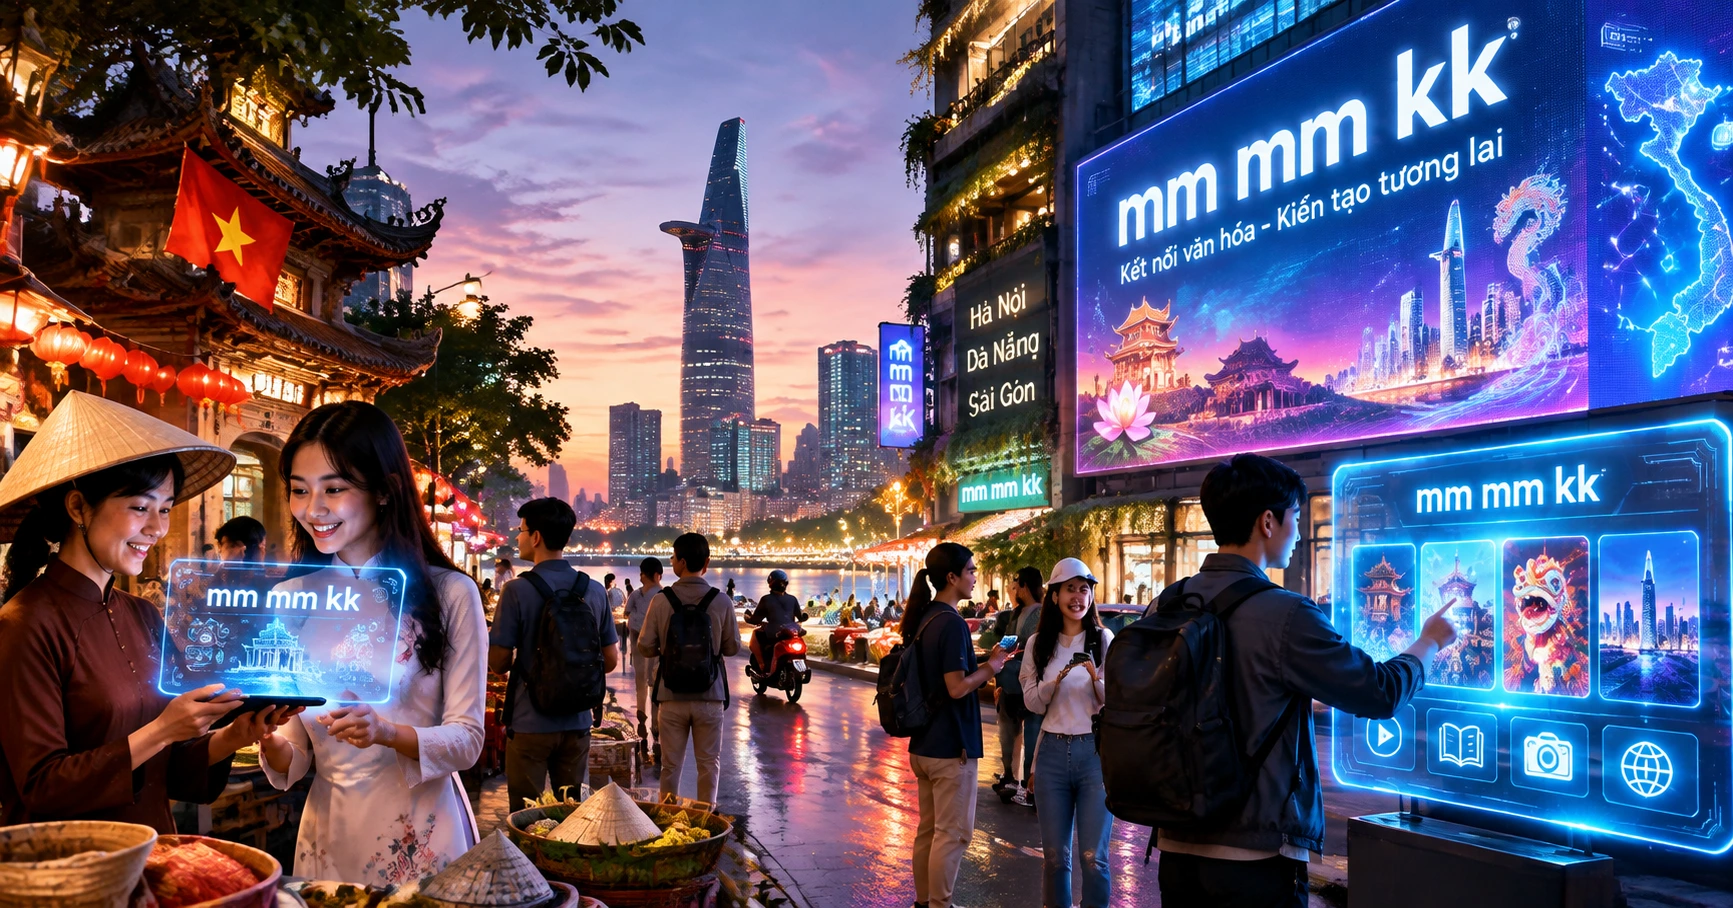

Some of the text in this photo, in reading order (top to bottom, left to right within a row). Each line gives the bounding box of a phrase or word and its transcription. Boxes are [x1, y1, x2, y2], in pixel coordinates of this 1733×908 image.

[1118, 24, 1508, 247] mm mm kk
[1183, 237, 1214, 262] văn
[1220, 221, 1255, 251] hóa
[1331, 183, 1371, 214] tạo
[1378, 151, 1459, 196] tương
[1469, 128, 1503, 166] lai
[962, 473, 1043, 503] mm mm kk
[1417, 464, 1600, 513] mm mm kk
[207, 585, 361, 612] mm mm kk
